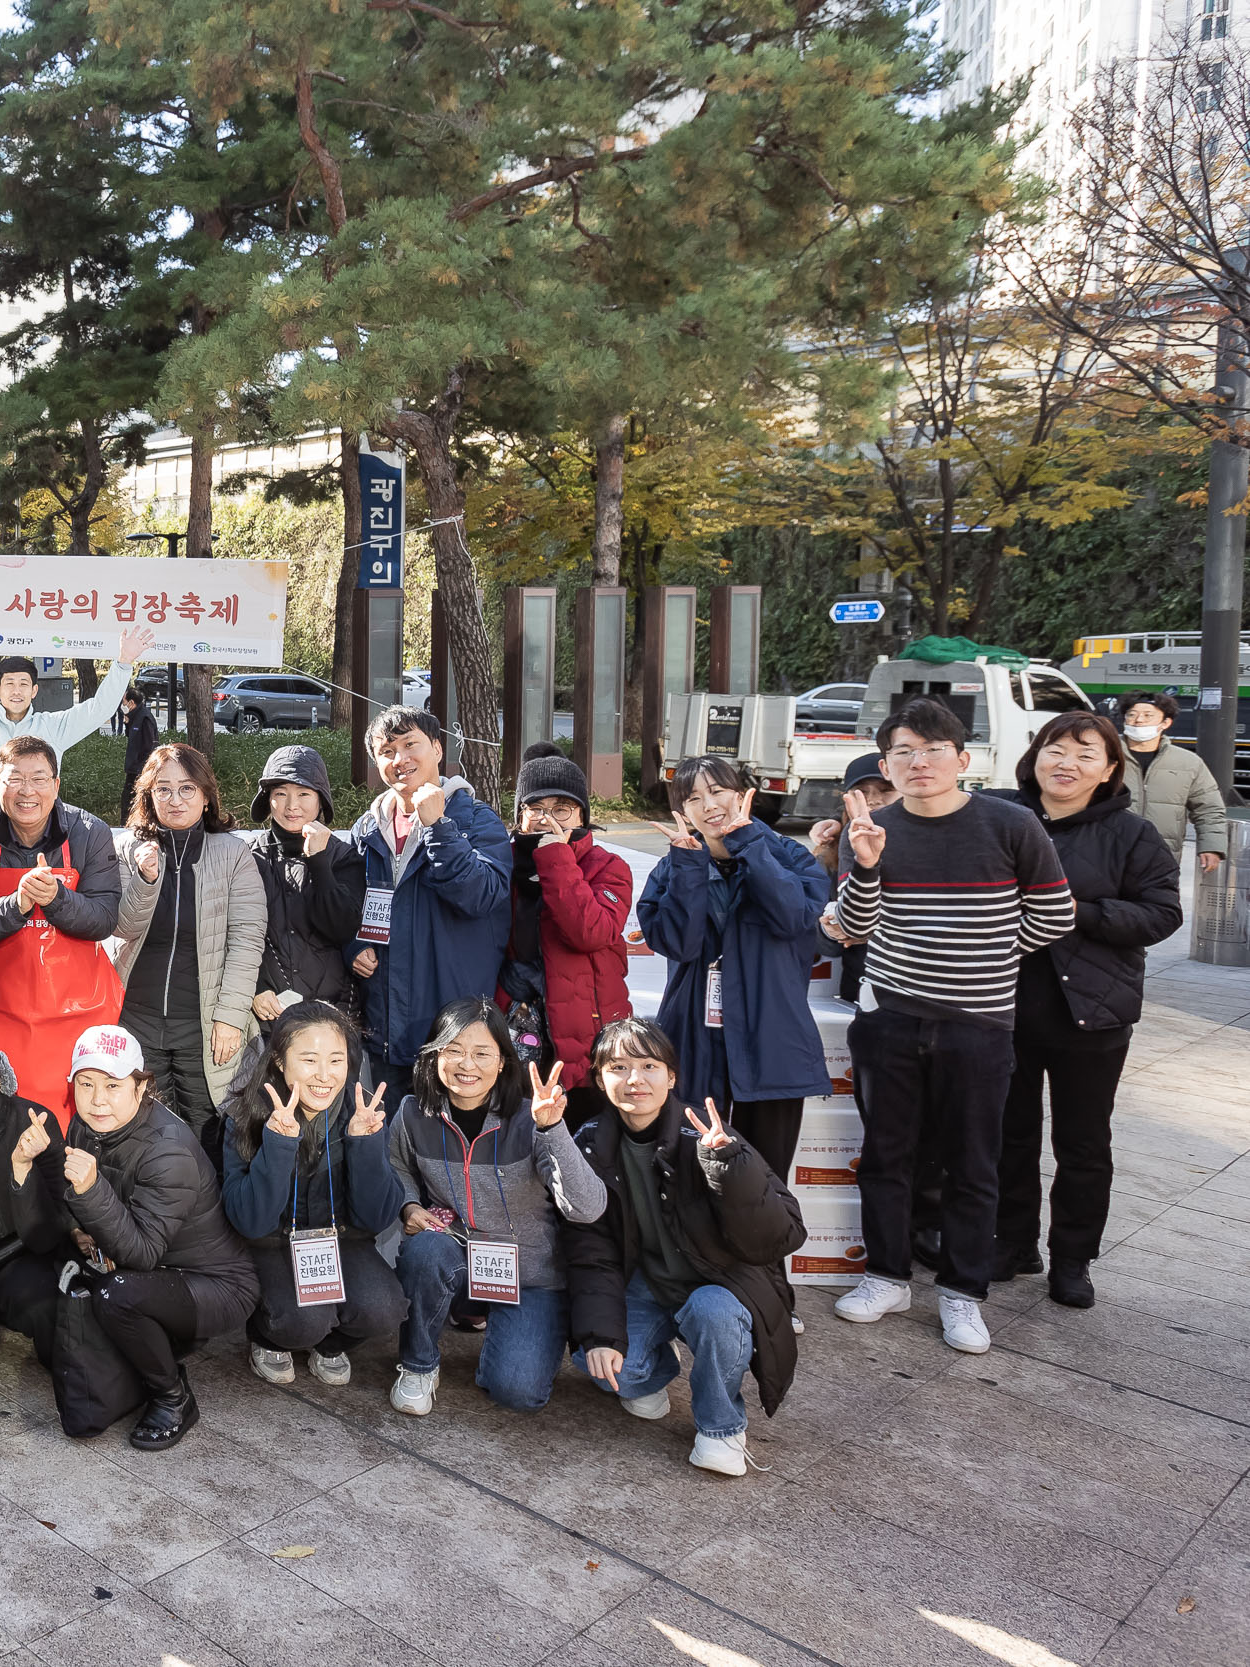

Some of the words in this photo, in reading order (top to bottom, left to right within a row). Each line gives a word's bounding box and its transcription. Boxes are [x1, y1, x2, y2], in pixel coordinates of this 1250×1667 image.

[370, 478, 396, 584] 광진구의
[5, 588, 98, 621] 사랑의
[111, 591, 239, 626] 김장축제
[43, 657, 54, 672] P
[1118, 663, 1148, 673] 쾌적한
[300, 1254, 333, 1266] STAFF
[475, 1256, 512, 1267] STAFF
[300, 1265, 335, 1278] 진행요원
[475, 1266, 513, 1279] 진행요원
